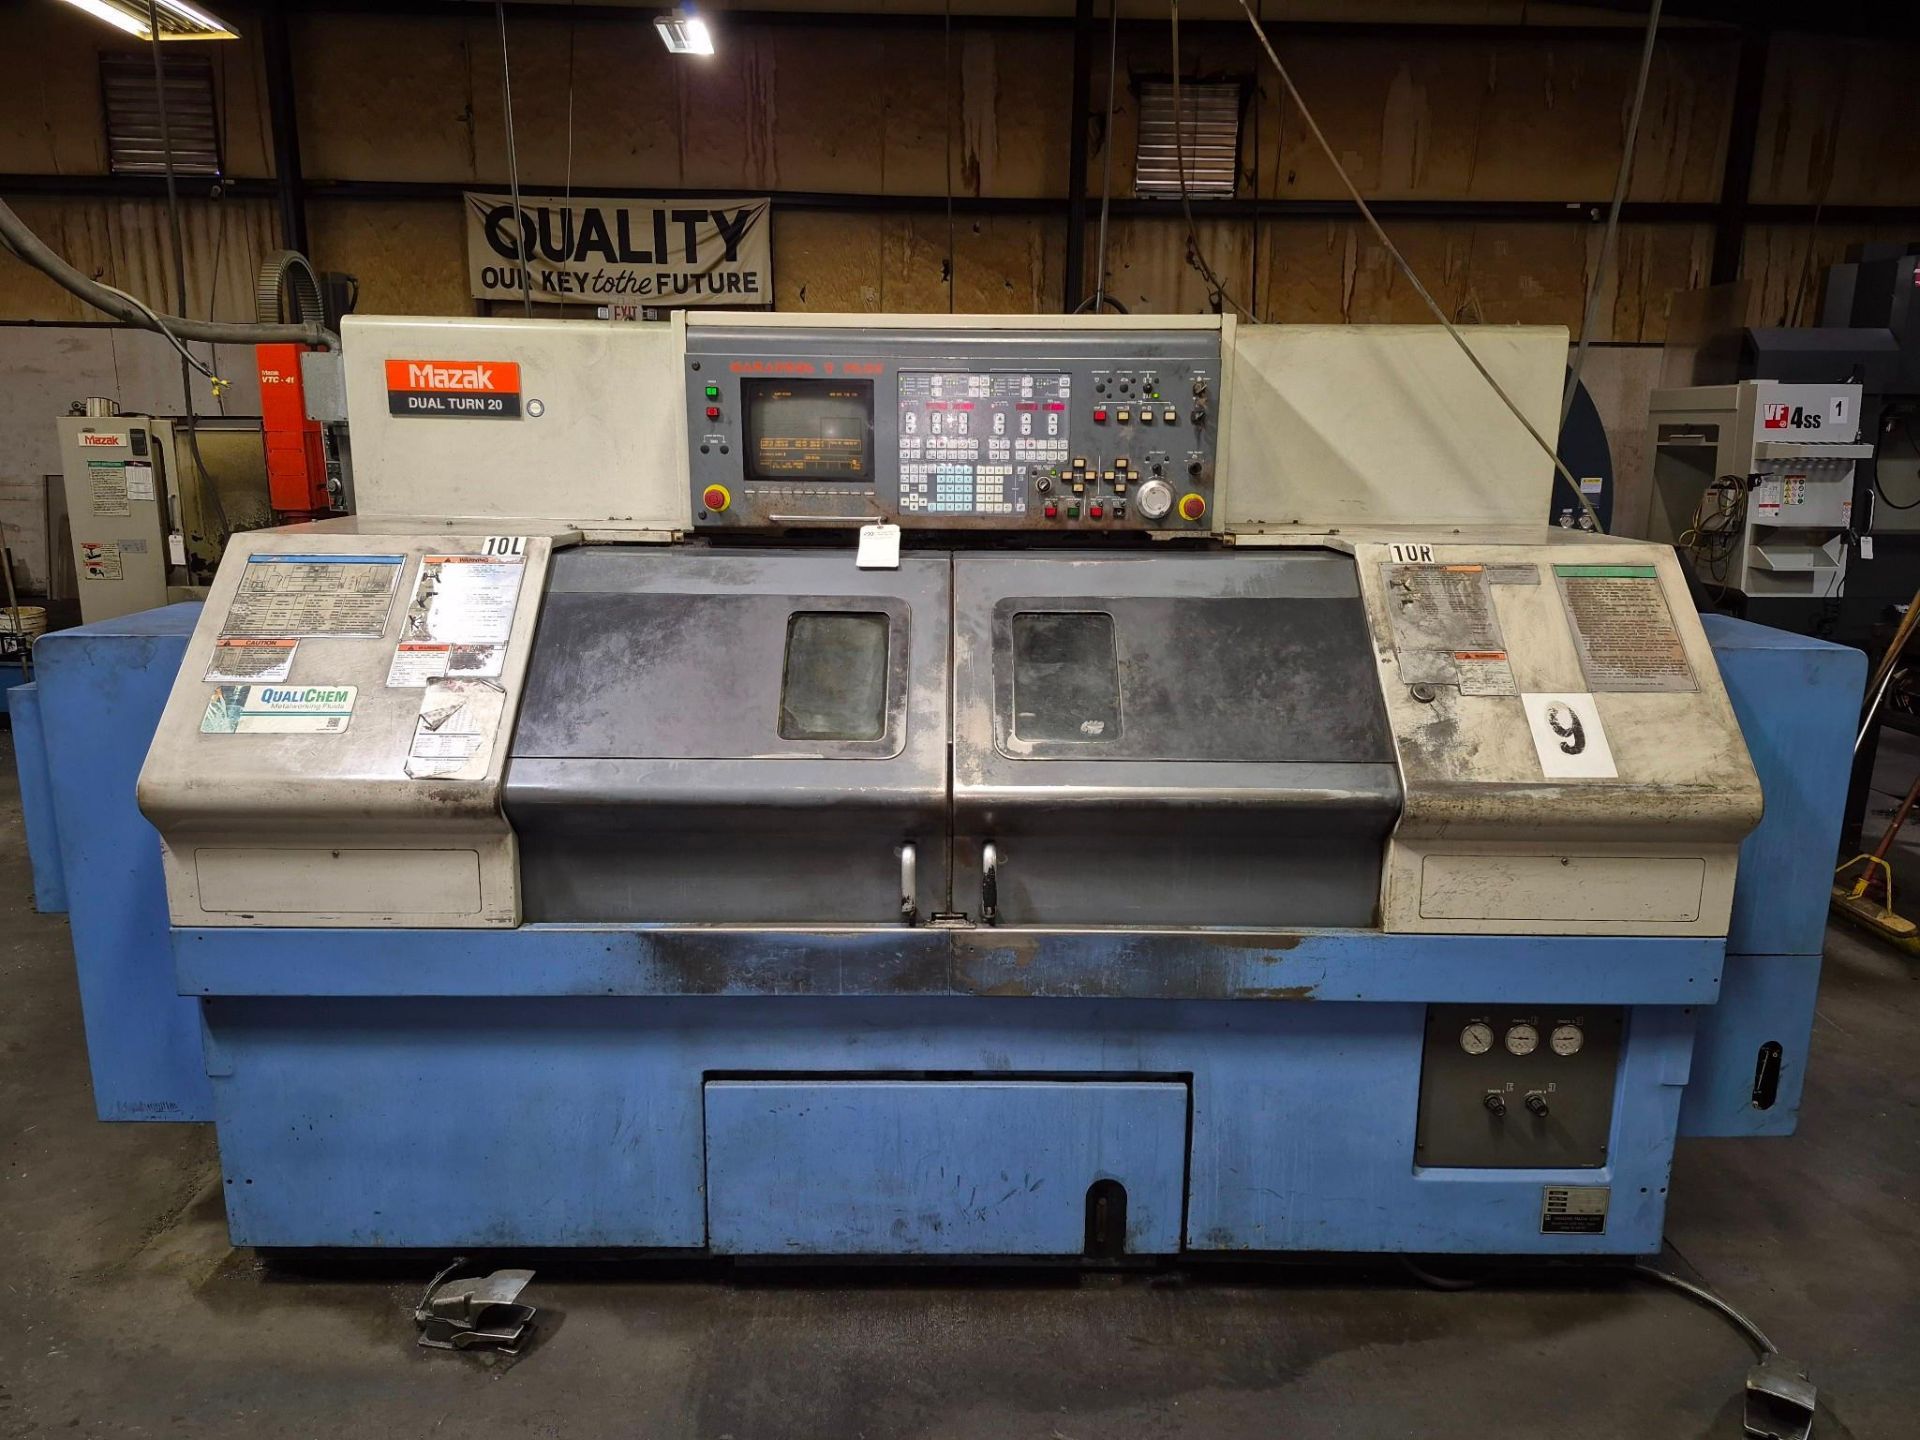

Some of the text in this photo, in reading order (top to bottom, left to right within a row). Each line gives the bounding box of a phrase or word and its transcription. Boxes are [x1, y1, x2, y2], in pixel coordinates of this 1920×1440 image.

[485, 205, 752, 264] QUALITY
[481, 267, 532, 291] OUR
[542, 270, 589, 293] KEY
[657, 271, 759, 294] FUTURE
[614, 305, 638, 321] EXIT
[409, 364, 494, 389] Mazak
[408, 397, 503, 411] DUAL TURN 20
[1763, 404, 1785, 420] VF
[1834, 401, 1843, 416] 1
[84, 435, 119, 445] Mazak
[487, 537, 521, 555] 10L
[1548, 701, 1586, 755] 9
